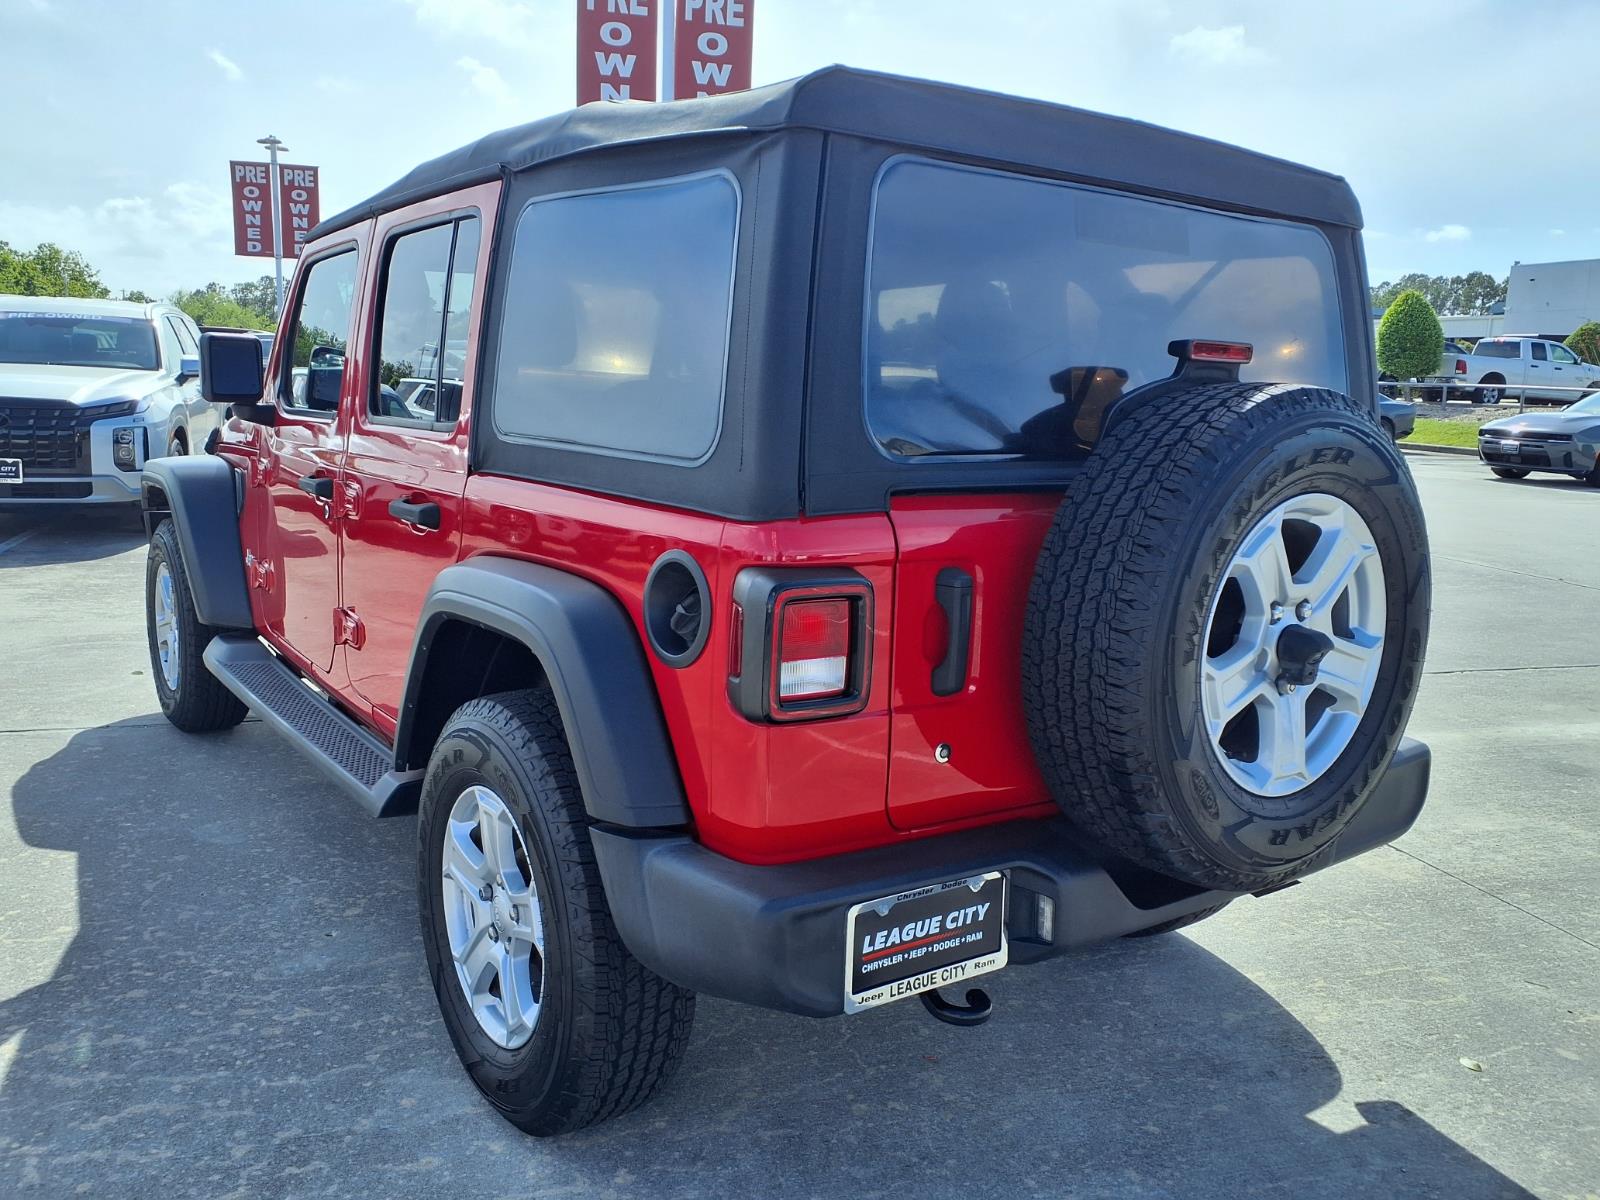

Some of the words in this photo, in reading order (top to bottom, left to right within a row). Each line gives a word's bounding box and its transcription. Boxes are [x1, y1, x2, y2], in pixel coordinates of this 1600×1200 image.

[684, 0, 745, 27] PRE
[234, 165, 267, 184] PRE
[283, 169, 315, 188] PRE
[241, 186, 263, 252] OWNED
[1183, 447, 1356, 667] WRANGLER
[1269, 627, 1421, 847] GOODYEAR
[896, 887, 935, 902] Chrysler
[941, 878, 968, 890] Dodge
[862, 915, 943, 954] LEAGUE
[945, 902, 991, 930] CITY
[861, 953, 903, 974] CHRYSLER
[908, 947, 928, 960] JEEP
[933, 938, 961, 952] DODGE
[965, 931, 983, 943] RAM
[857, 992, 884, 1005] Jeep
[889, 972, 938, 998] LEAGUE
[941, 963, 968, 982] CITY
[974, 958, 996, 970] Ram
